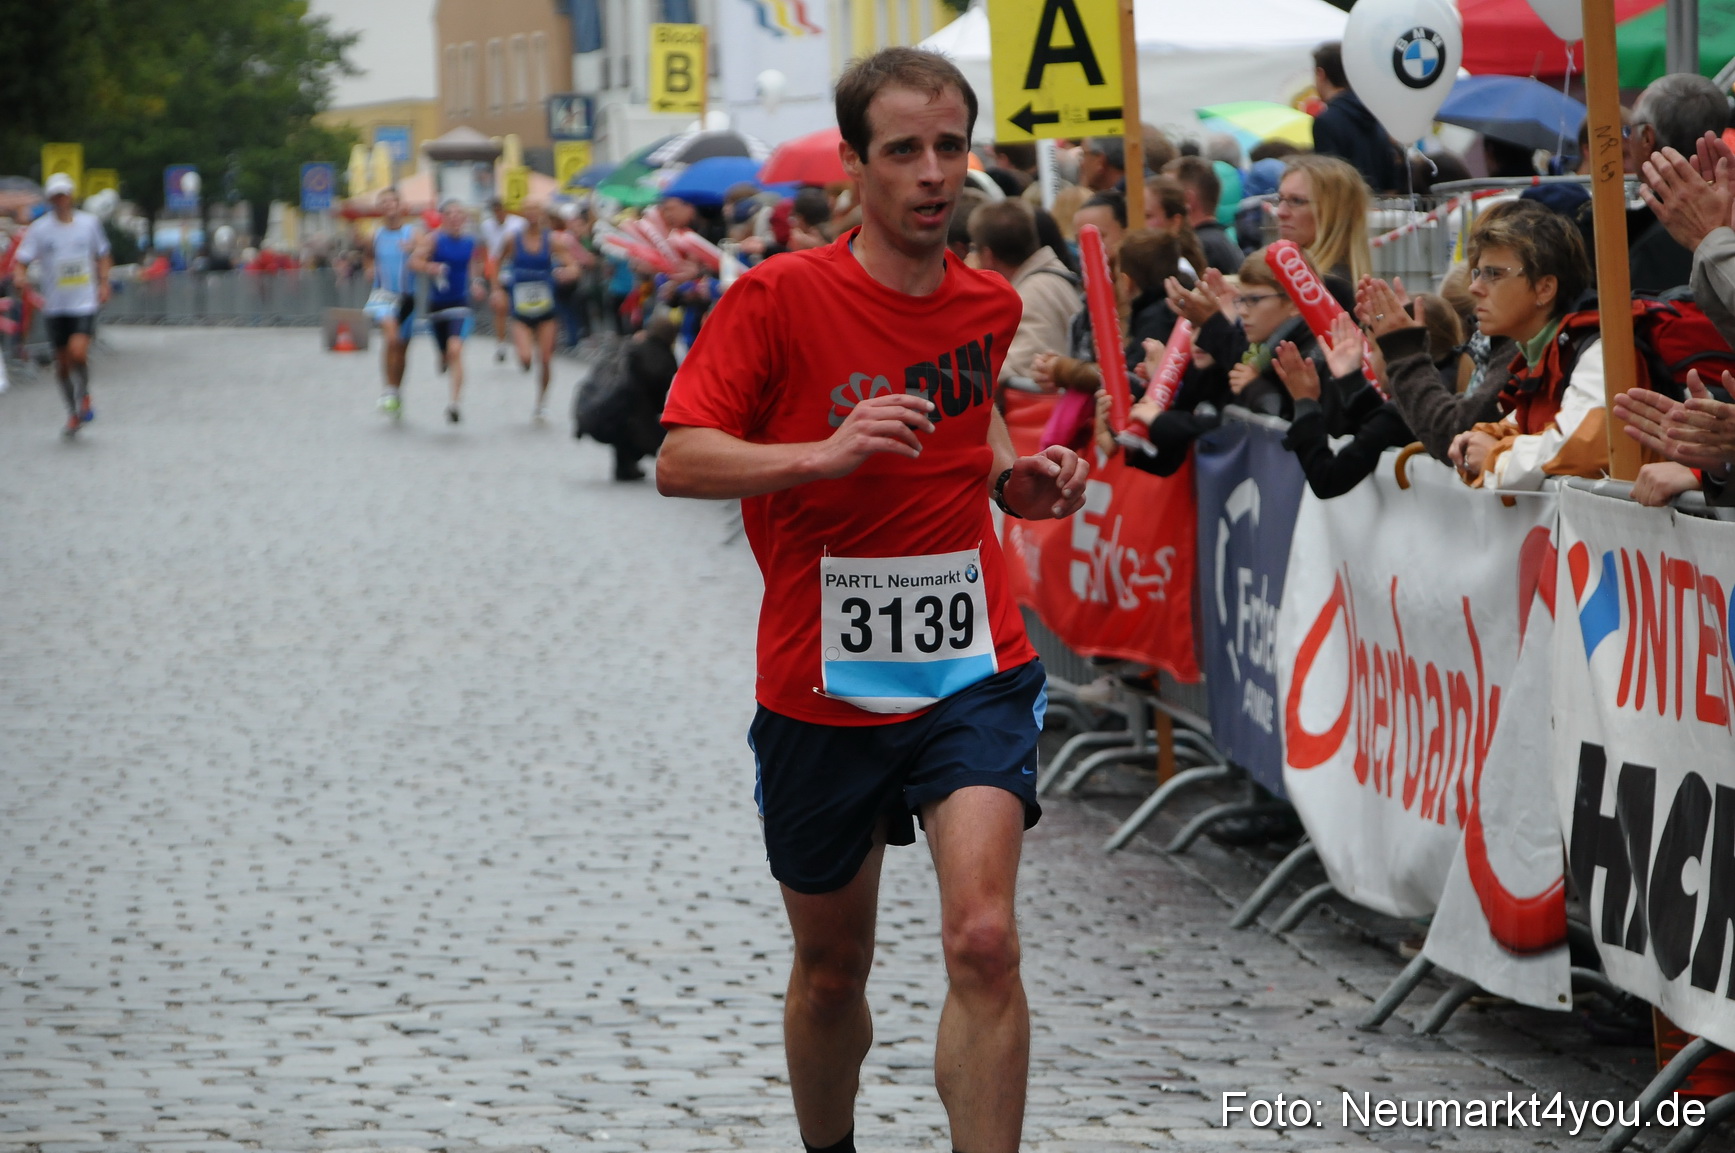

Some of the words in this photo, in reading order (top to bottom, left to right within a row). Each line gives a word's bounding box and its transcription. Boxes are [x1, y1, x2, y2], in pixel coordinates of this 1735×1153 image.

[1023, 0, 1107, 89] A
[1395, 27, 1445, 51] BMW
[664, 51, 693, 92] B
[905, 332, 993, 431] RUN
[825, 573, 884, 588] PARTL
[888, 570, 961, 588] Neumarkt
[840, 592, 974, 653] 3139
[1286, 561, 1502, 831] Oberbank
